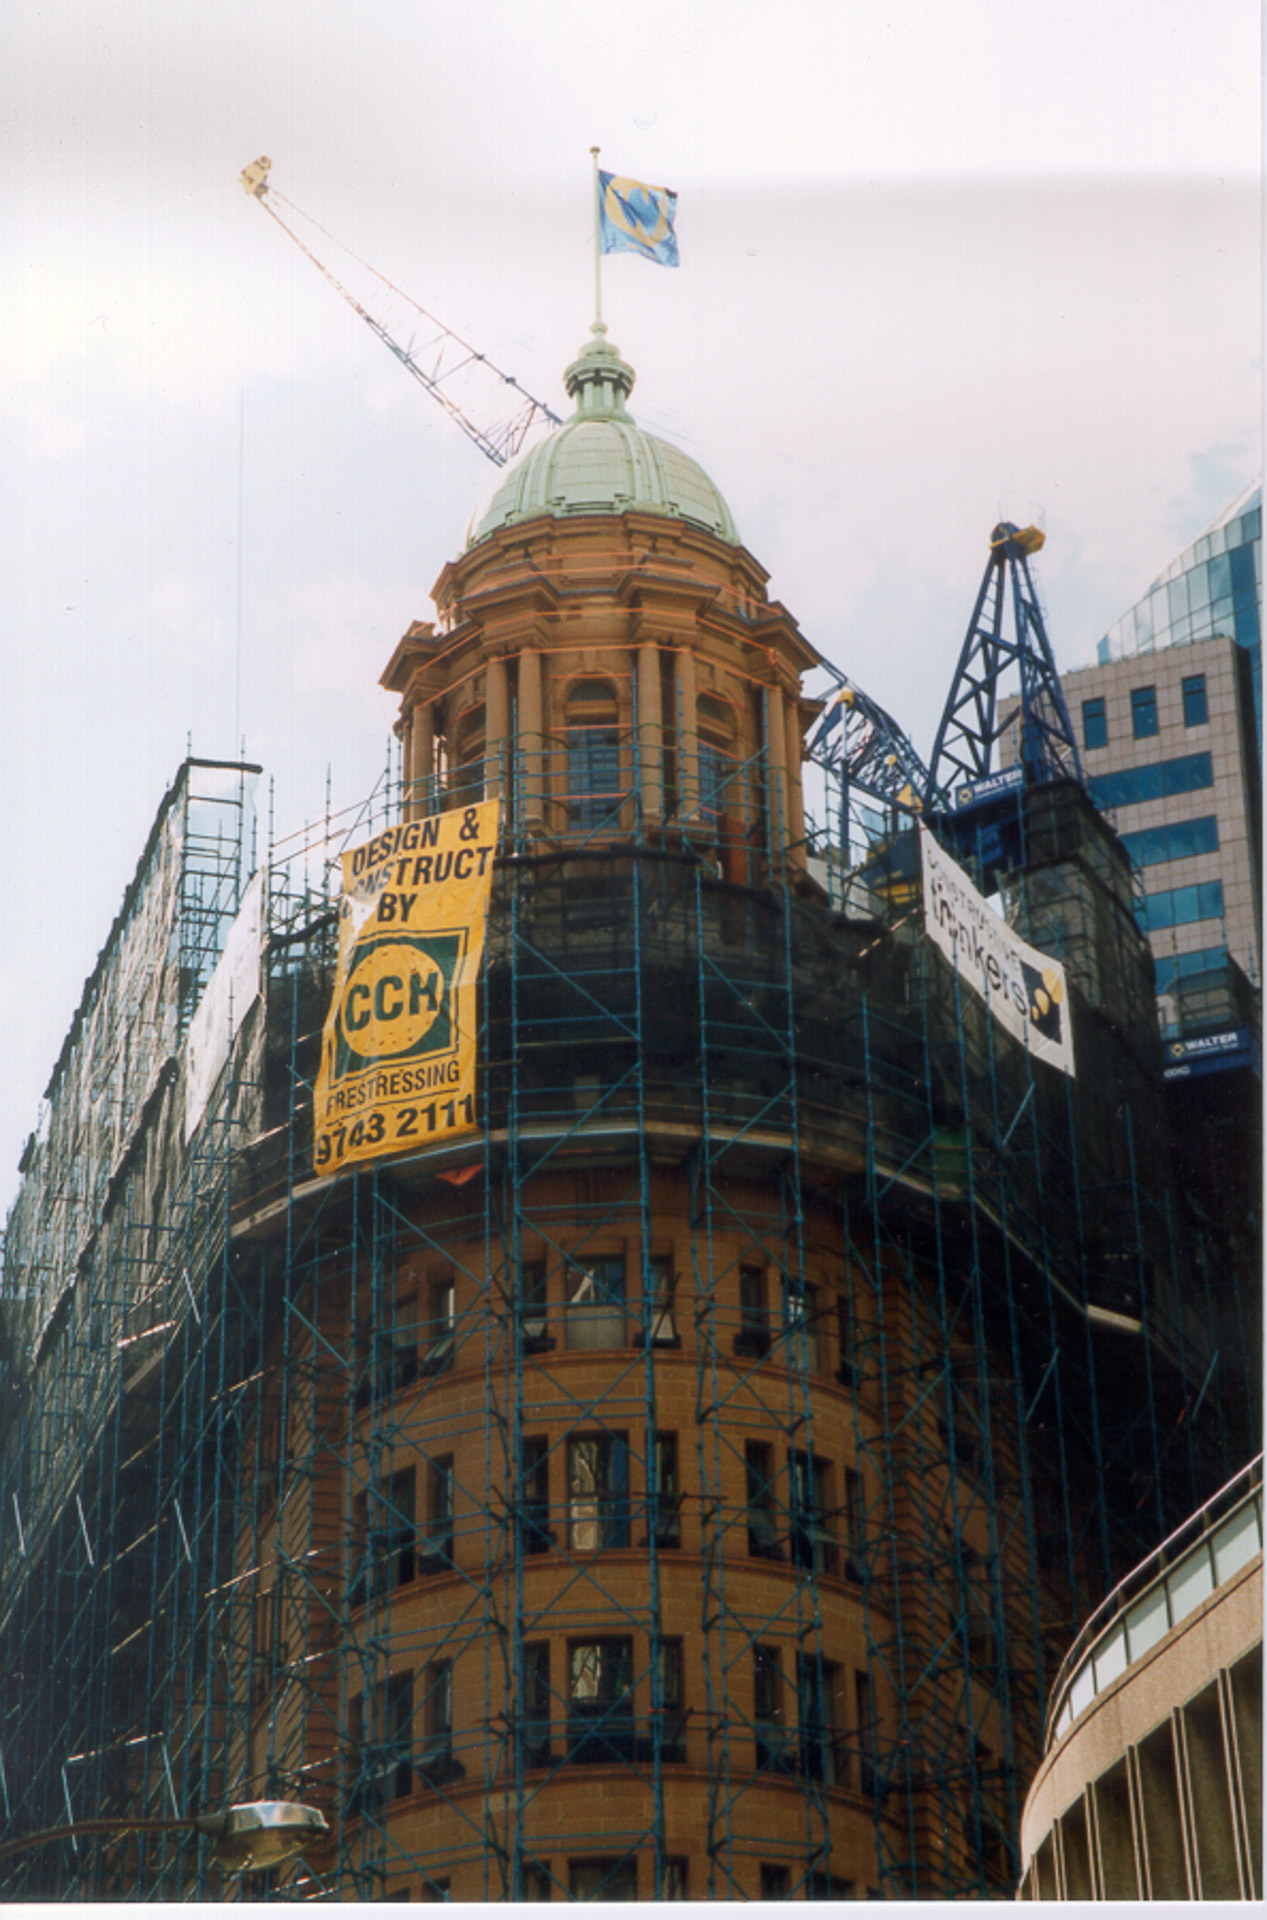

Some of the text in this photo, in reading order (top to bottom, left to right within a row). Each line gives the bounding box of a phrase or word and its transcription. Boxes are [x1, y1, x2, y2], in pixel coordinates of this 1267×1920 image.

[352, 808, 479, 876] DESIGN &
[377, 892, 418, 922] BY
[345, 971, 440, 1033] CCH
[1185, 1032, 1238, 1051] WALTER
[315, 1094, 474, 1165] 9743 2111
